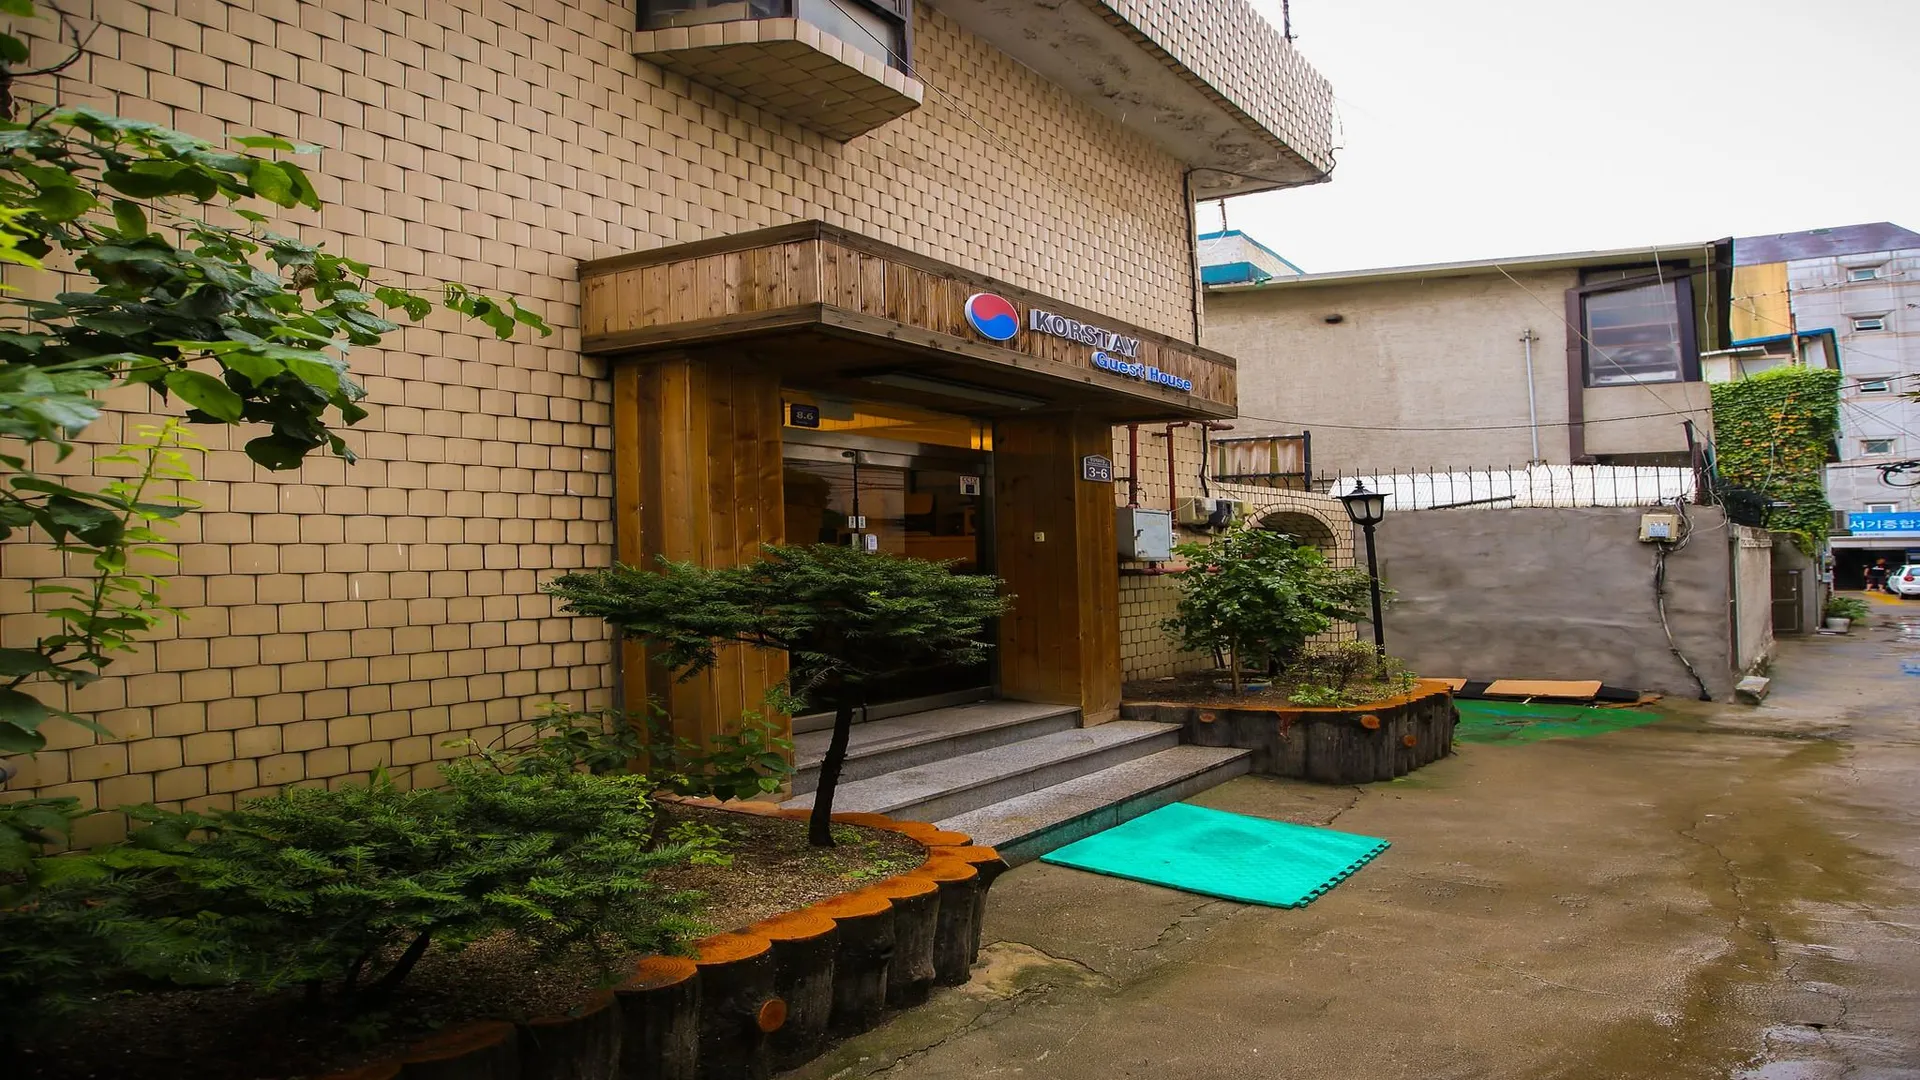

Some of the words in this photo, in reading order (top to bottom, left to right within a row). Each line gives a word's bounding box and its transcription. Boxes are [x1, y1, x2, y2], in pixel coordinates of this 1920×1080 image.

[1031, 309, 1139, 357] KORSTAY
[1093, 352, 1145, 379] Guest
[1147, 366, 1193, 391] House
[796, 411, 814, 420] 8.6
[1088, 466, 1108, 479] 3-6
[1850, 519, 1920, 530] 서기종합
